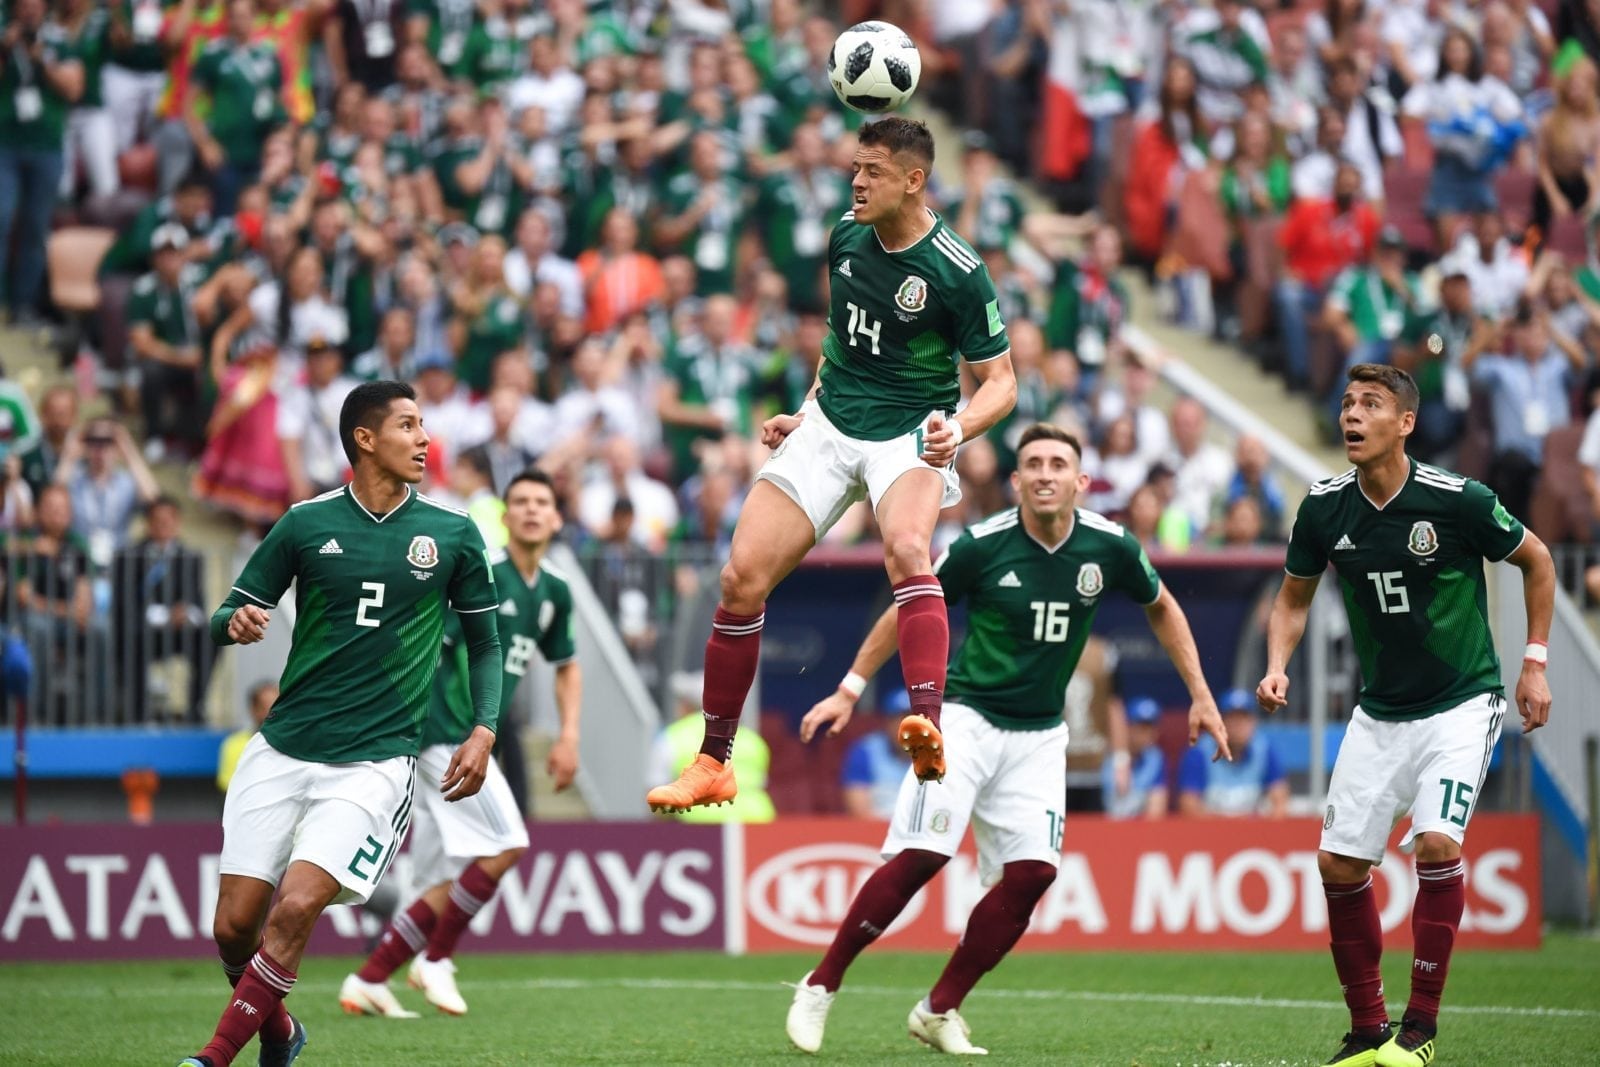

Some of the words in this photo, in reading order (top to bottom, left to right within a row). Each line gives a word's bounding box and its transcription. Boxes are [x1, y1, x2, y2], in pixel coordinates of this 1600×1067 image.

[847, 301, 882, 355] 14
[910, 428, 925, 458] 1
[355, 581, 385, 627] 2
[1367, 571, 1411, 614] 15
[1030, 601, 1070, 642] 16
[1440, 778, 1474, 828] 15
[347, 834, 385, 881] 2
[325, 848, 716, 936] WAYS
[944, 852, 1109, 934] KA
[1414, 958, 1438, 973] FMF
[233, 998, 258, 1016] FMF
